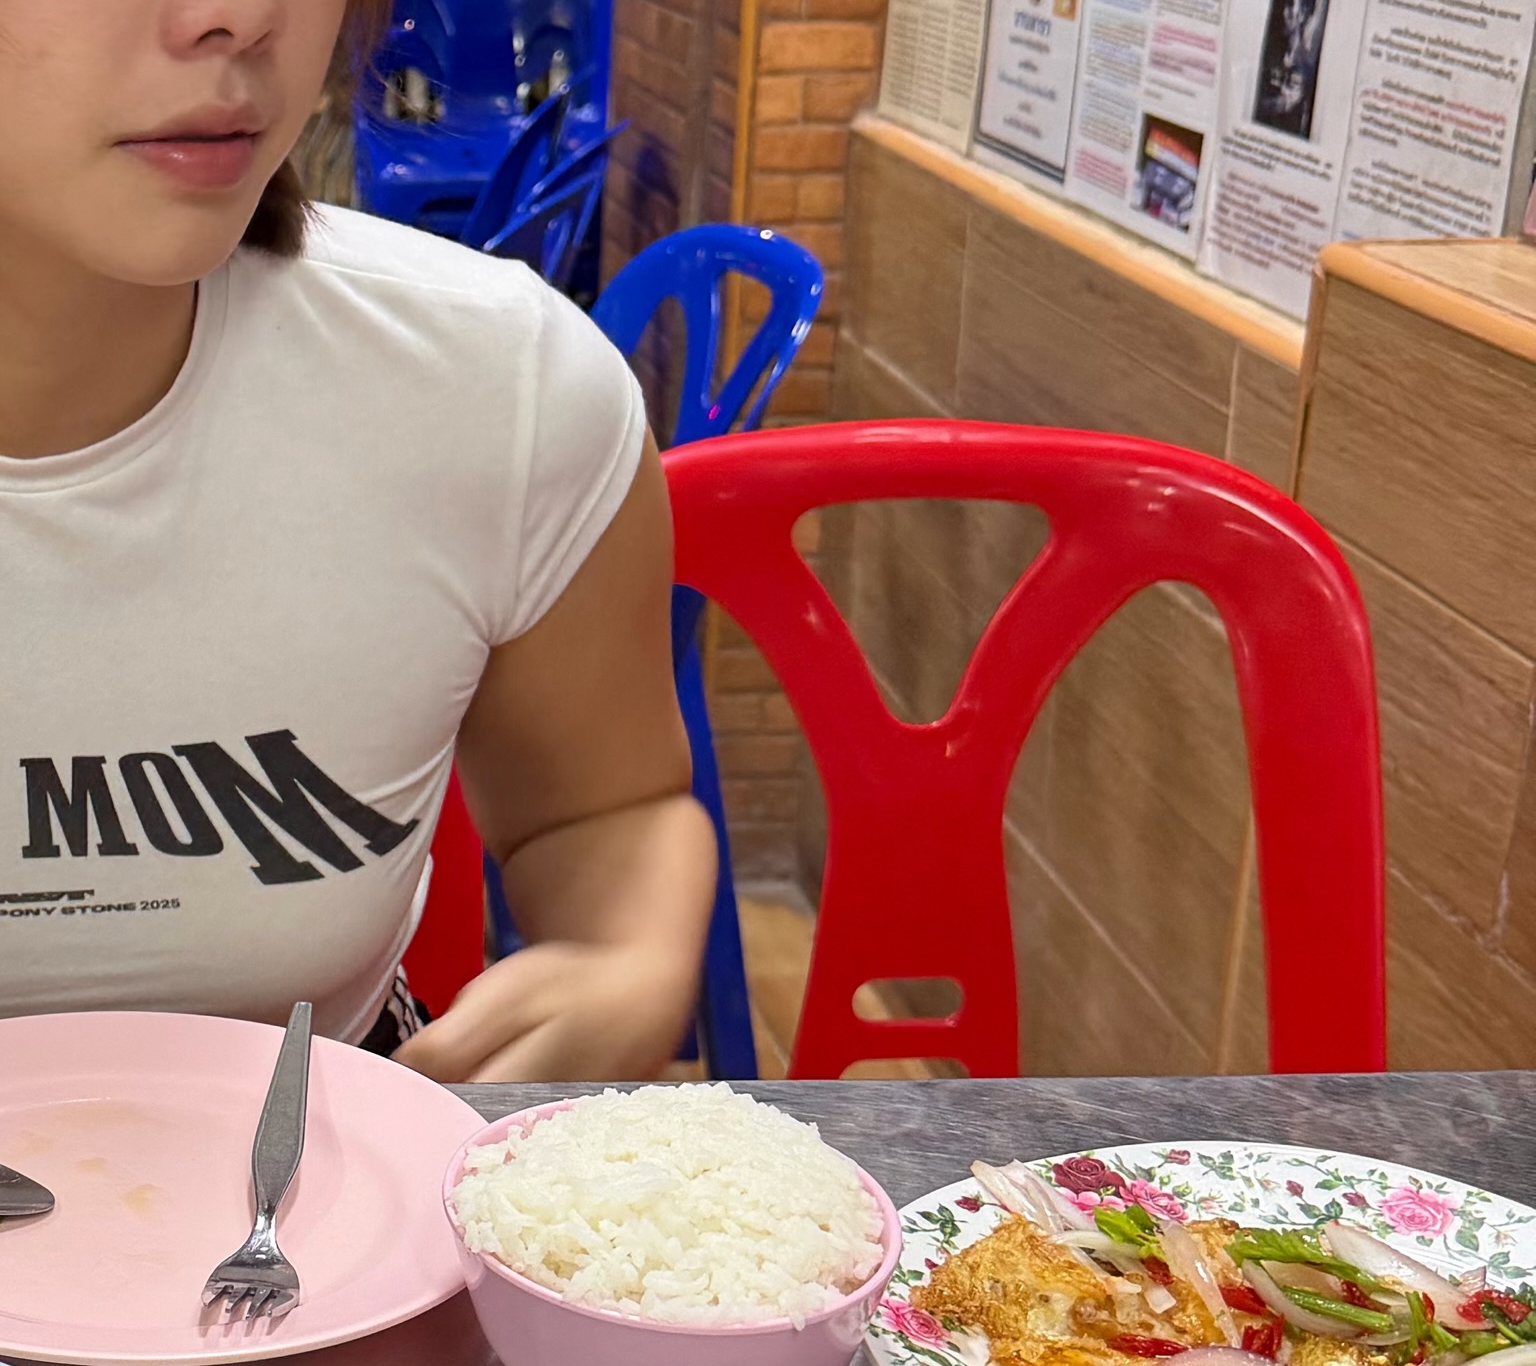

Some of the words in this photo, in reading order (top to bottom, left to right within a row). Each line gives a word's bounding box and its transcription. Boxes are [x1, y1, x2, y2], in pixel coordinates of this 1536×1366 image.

[20, 728, 421, 885] MOM
[60, 902, 136, 915] STONE
[139, 897, 181, 911] 2025
